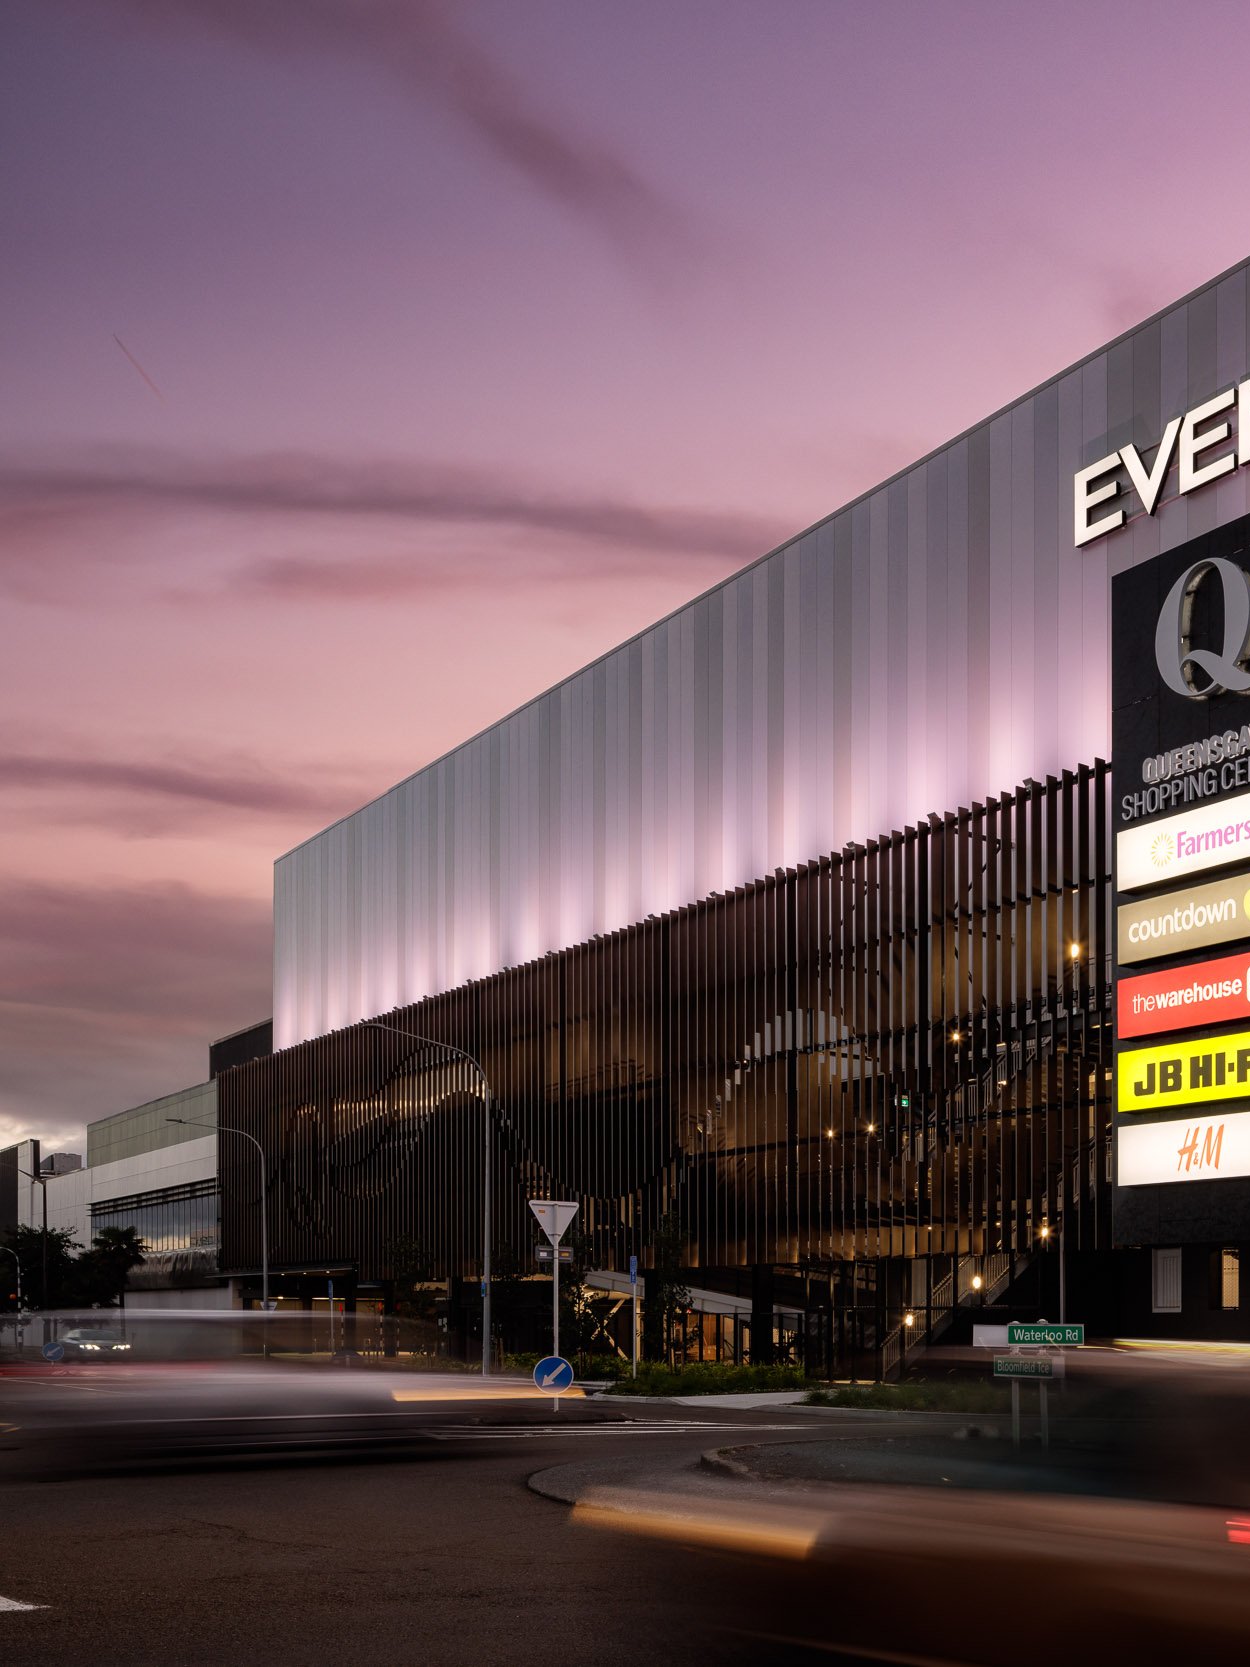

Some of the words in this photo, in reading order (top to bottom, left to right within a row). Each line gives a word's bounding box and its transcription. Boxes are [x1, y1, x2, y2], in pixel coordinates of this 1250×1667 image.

[1122, 769, 1218, 821] SHOPPING
[1128, 898, 1237, 943] countdown
[1133, 1058, 1183, 1097] JB
[1177, 1123, 1225, 1172] H&M
[1013, 1328, 1063, 1341] Waterloo
[1065, 1329, 1079, 1341] Rd
[997, 1360, 1036, 1373] Bloomfield
[1037, 1361, 1049, 1373] Tce
